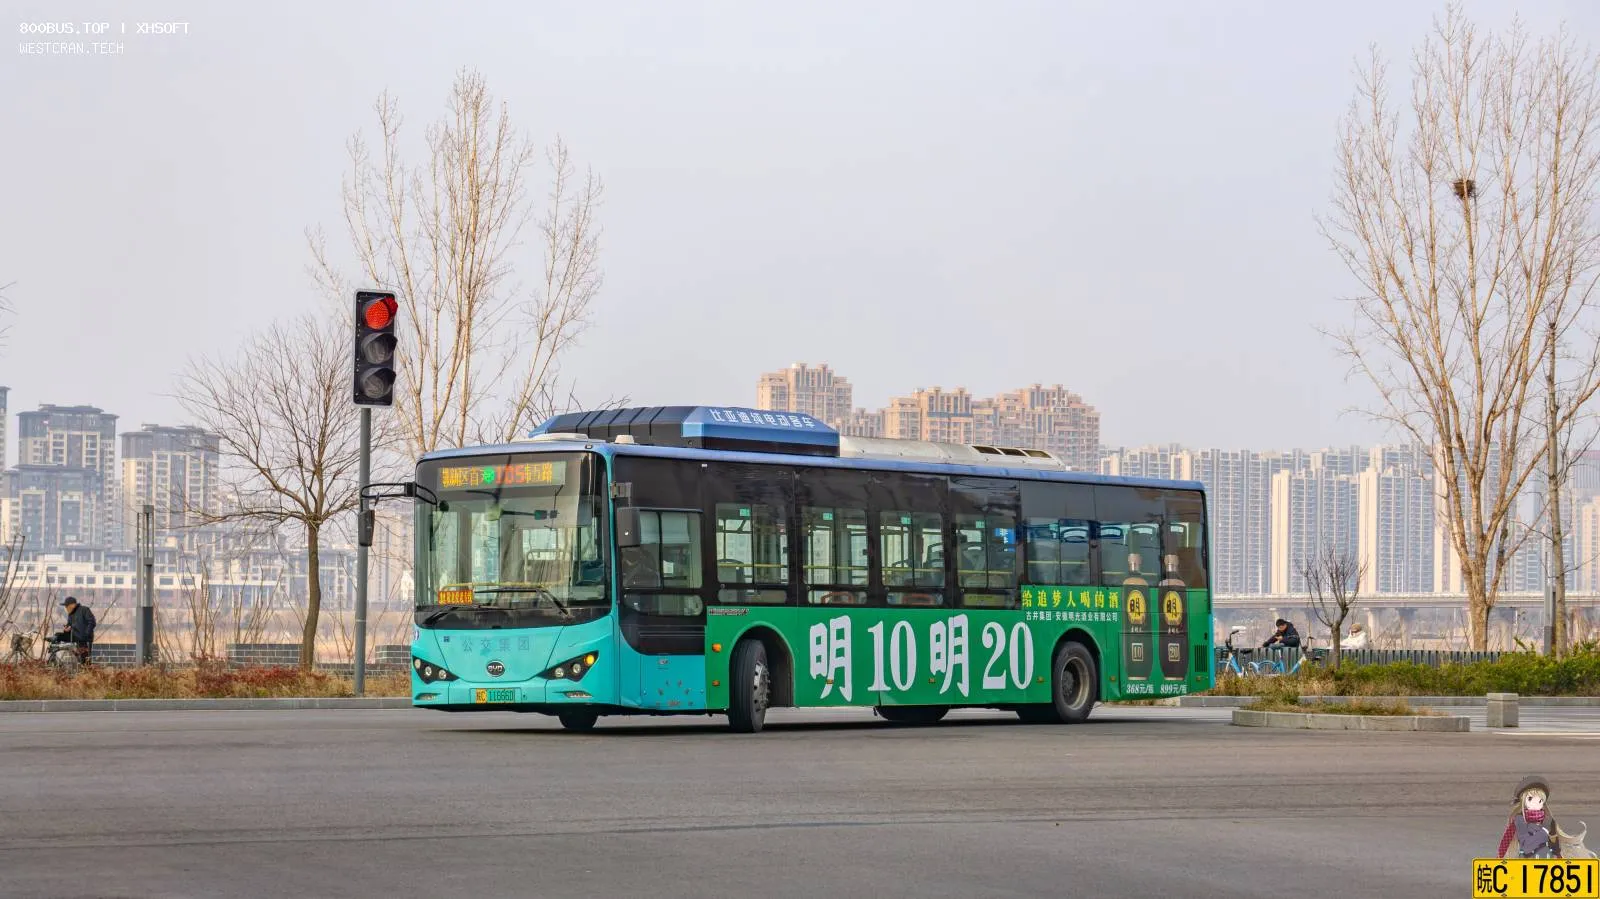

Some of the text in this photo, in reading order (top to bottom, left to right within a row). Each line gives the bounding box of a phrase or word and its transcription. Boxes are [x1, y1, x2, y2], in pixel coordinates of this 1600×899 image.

[709, 408, 815, 428] 比亚迪纯电动客车
[1022, 590, 1119, 609] 给追梦人喝的酒
[1130, 598, 1140, 616] 明
[462, 636, 530, 652] 公交集团
[809, 613, 1034, 702] 明 10 明 20
